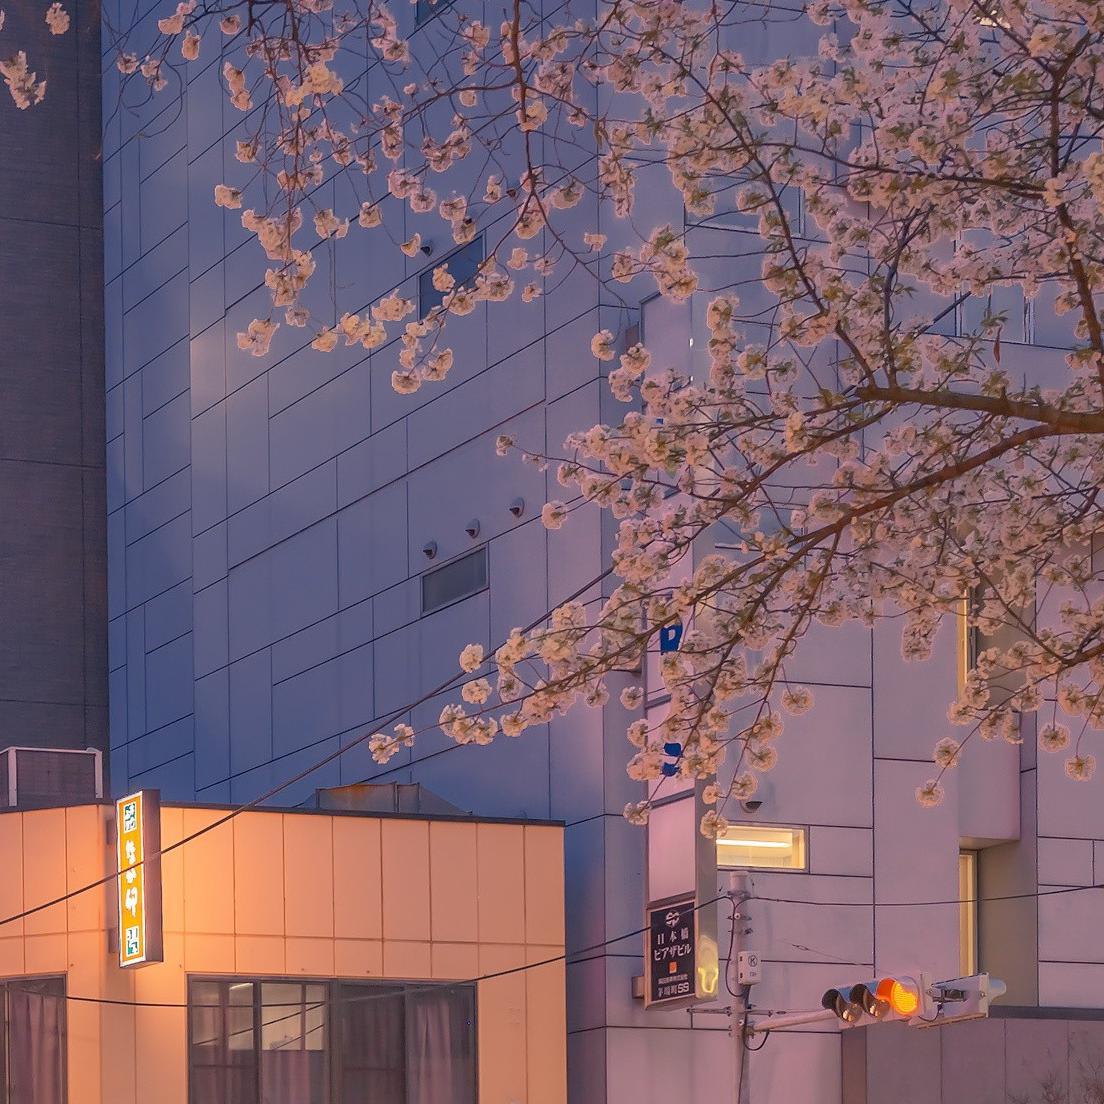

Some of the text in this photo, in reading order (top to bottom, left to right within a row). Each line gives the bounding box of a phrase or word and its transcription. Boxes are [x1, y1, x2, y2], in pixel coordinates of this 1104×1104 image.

[654, 943, 692, 961] ピアザビル
